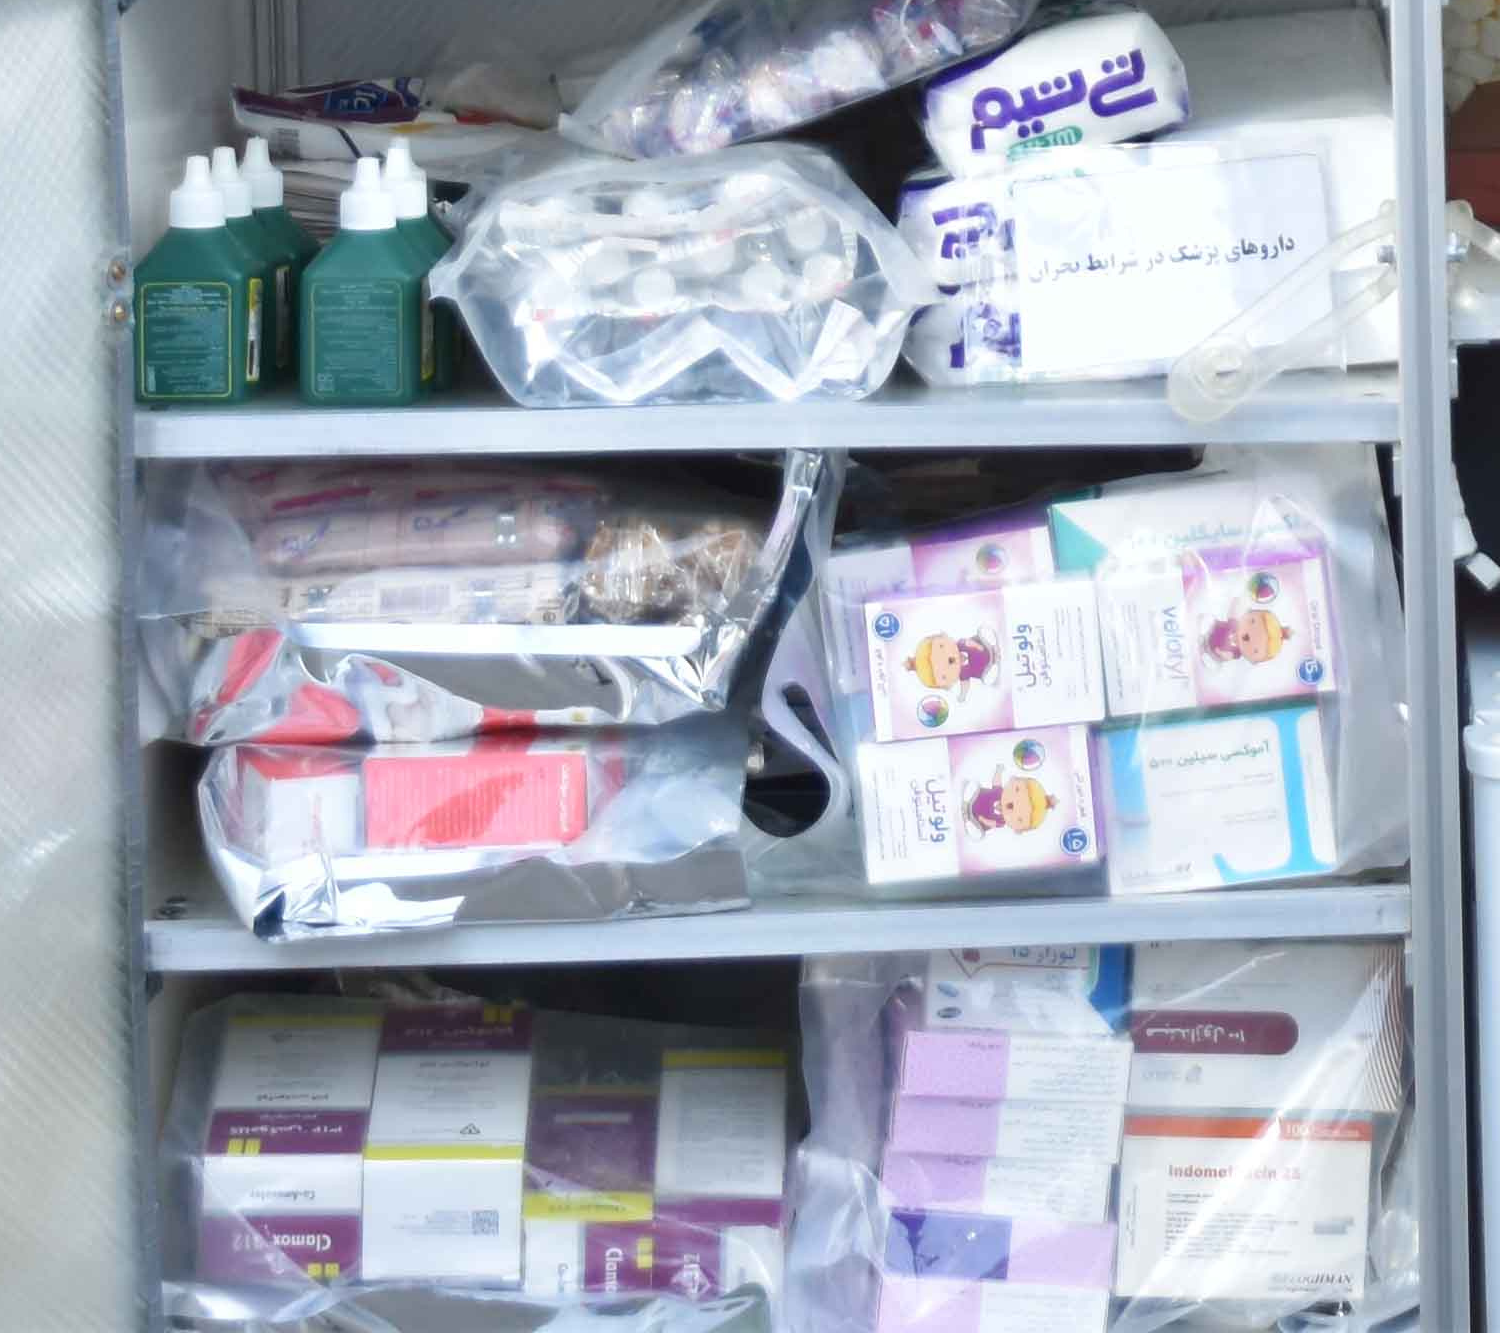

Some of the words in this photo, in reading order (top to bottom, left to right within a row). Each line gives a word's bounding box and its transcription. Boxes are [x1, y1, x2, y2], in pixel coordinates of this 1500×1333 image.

[1226, 234, 1295, 262] داروهای
[1087, 253, 1139, 275] شرایط
[1147, 251, 1164, 272] در
[1012, 623, 1039, 688] ولوتیل
[1162, 606, 1189, 681] velotyl
[926, 778, 948, 843] ولوتیل
[1146, 1024, 1225, 1043] مبندازول
[273, 1233, 332, 1252] Clamox
